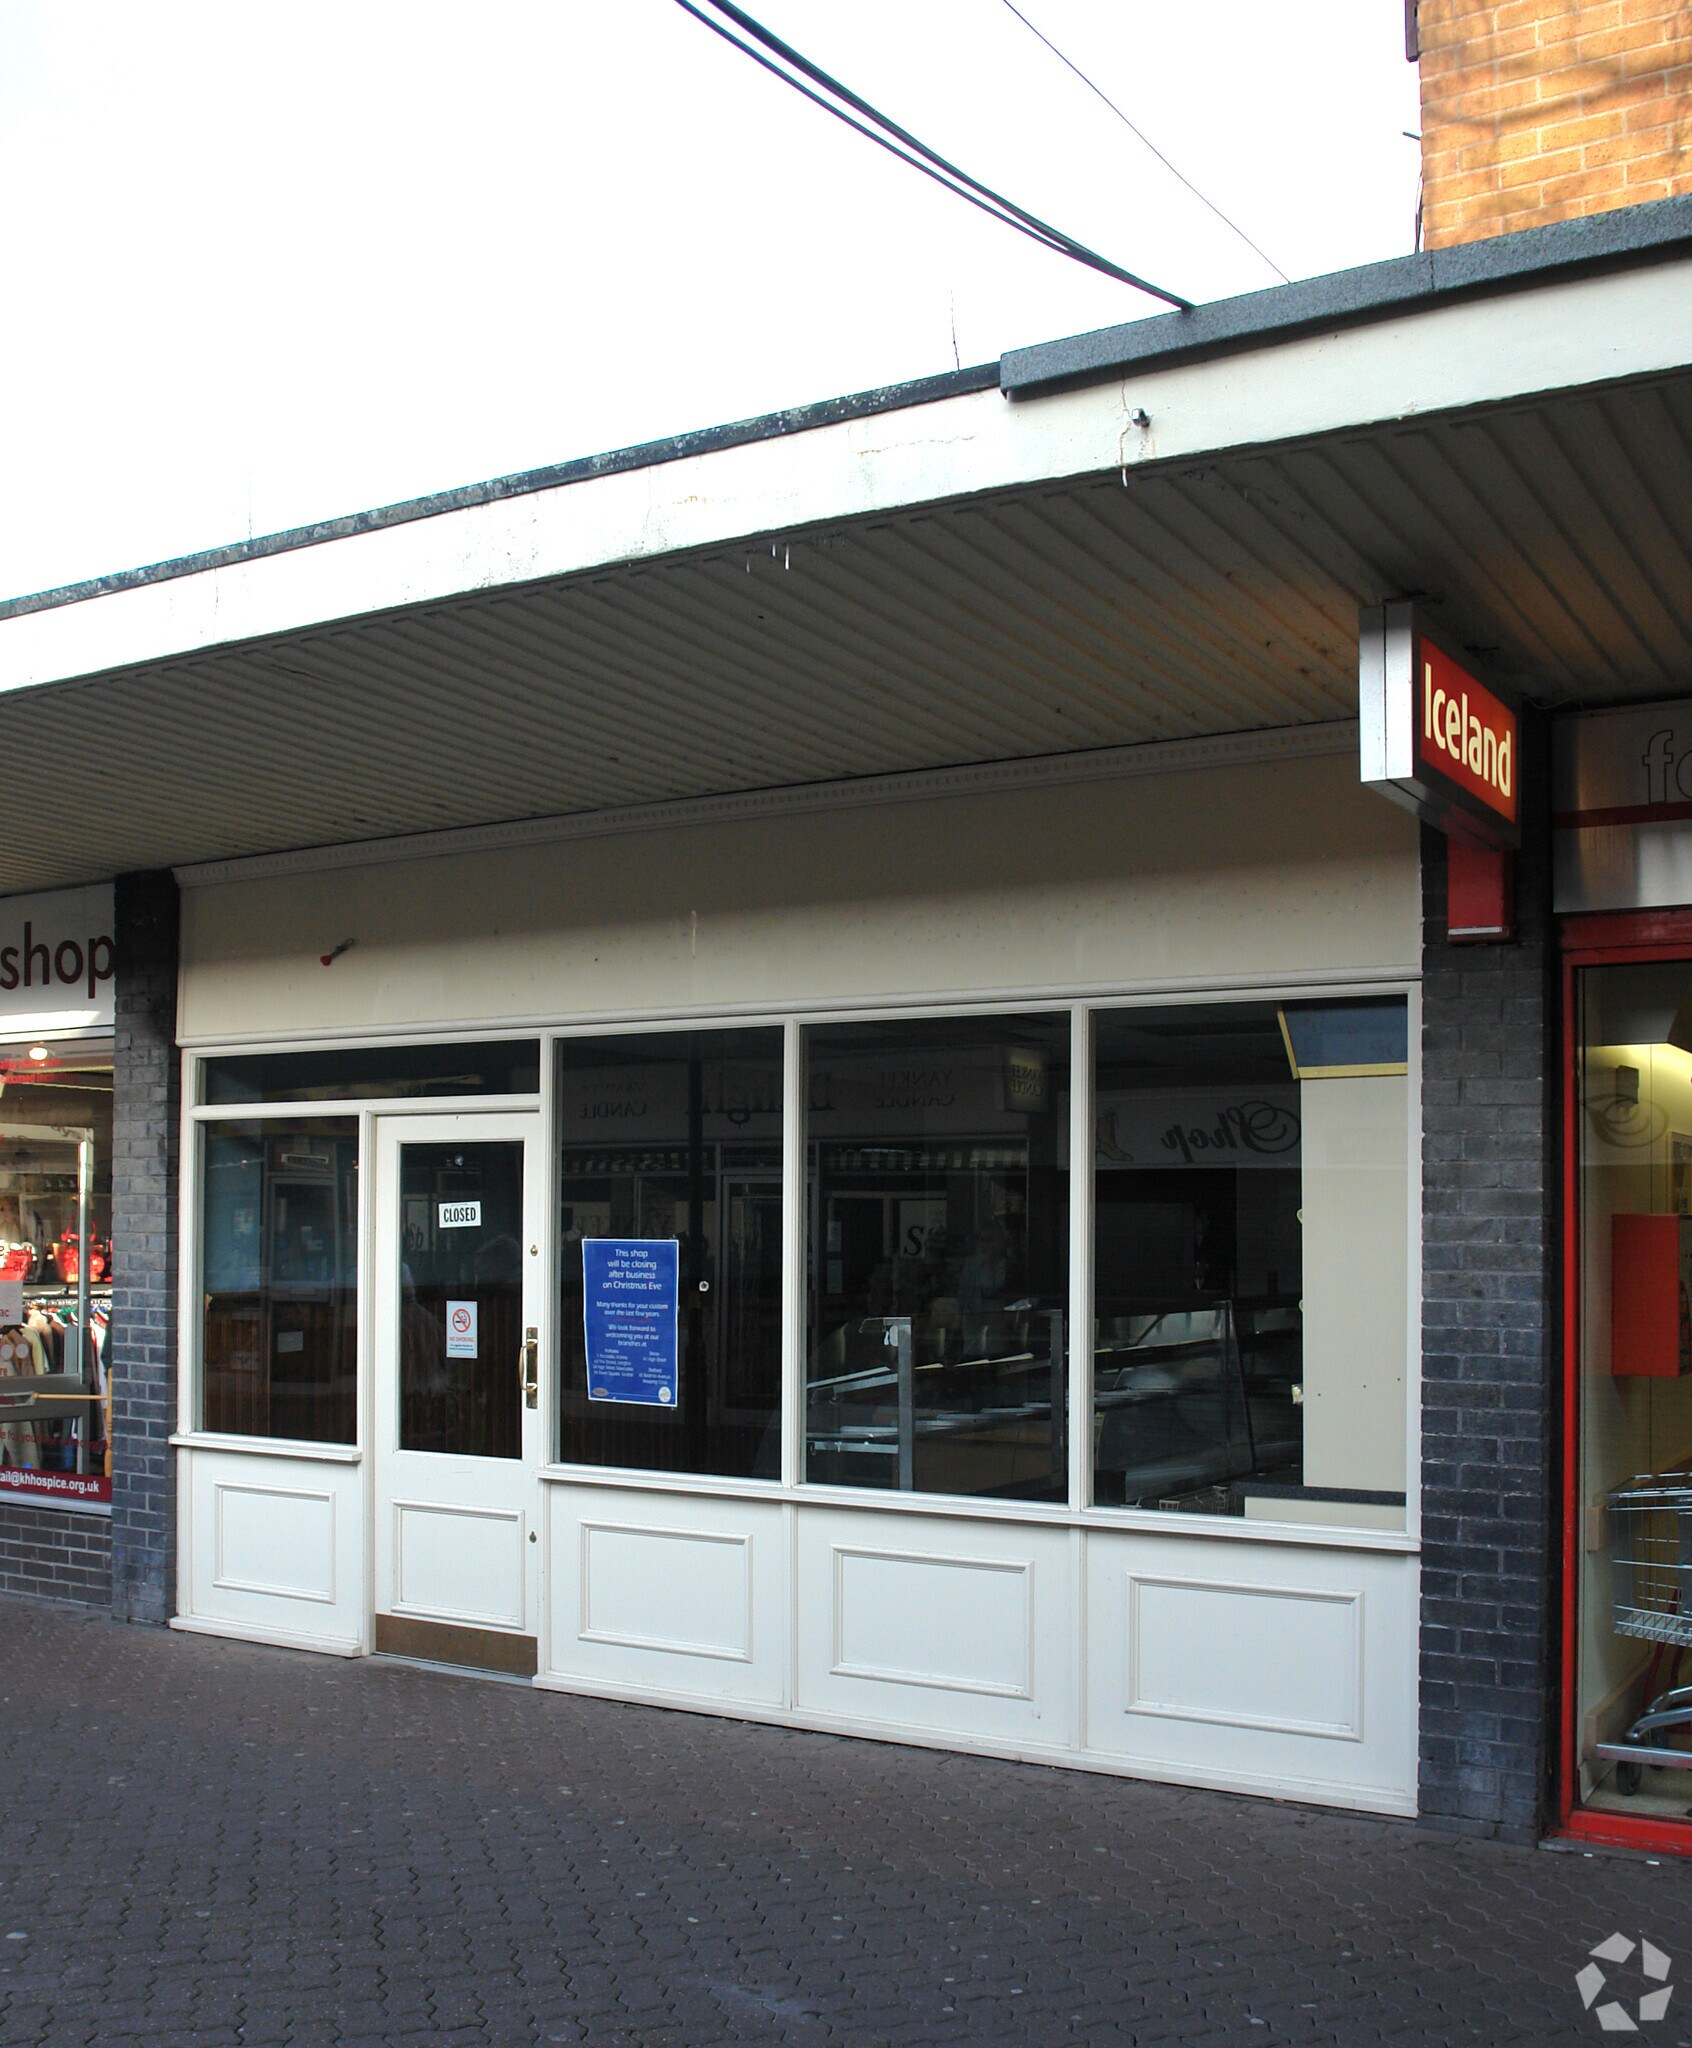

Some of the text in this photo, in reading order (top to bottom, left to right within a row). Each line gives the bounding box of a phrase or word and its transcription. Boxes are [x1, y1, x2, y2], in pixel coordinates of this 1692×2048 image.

[1425, 662, 1511, 797] Iceland
[0, 921, 114, 999] shop
[443, 1207, 476, 1223] CLOSED
[615, 1248, 649, 1259] This shop
[607, 1260, 657, 1270] will be closing
[608, 1270, 656, 1279] after business
[613, 1281, 647, 1290] Christmas
[648, 1282, 662, 1290] Eve
